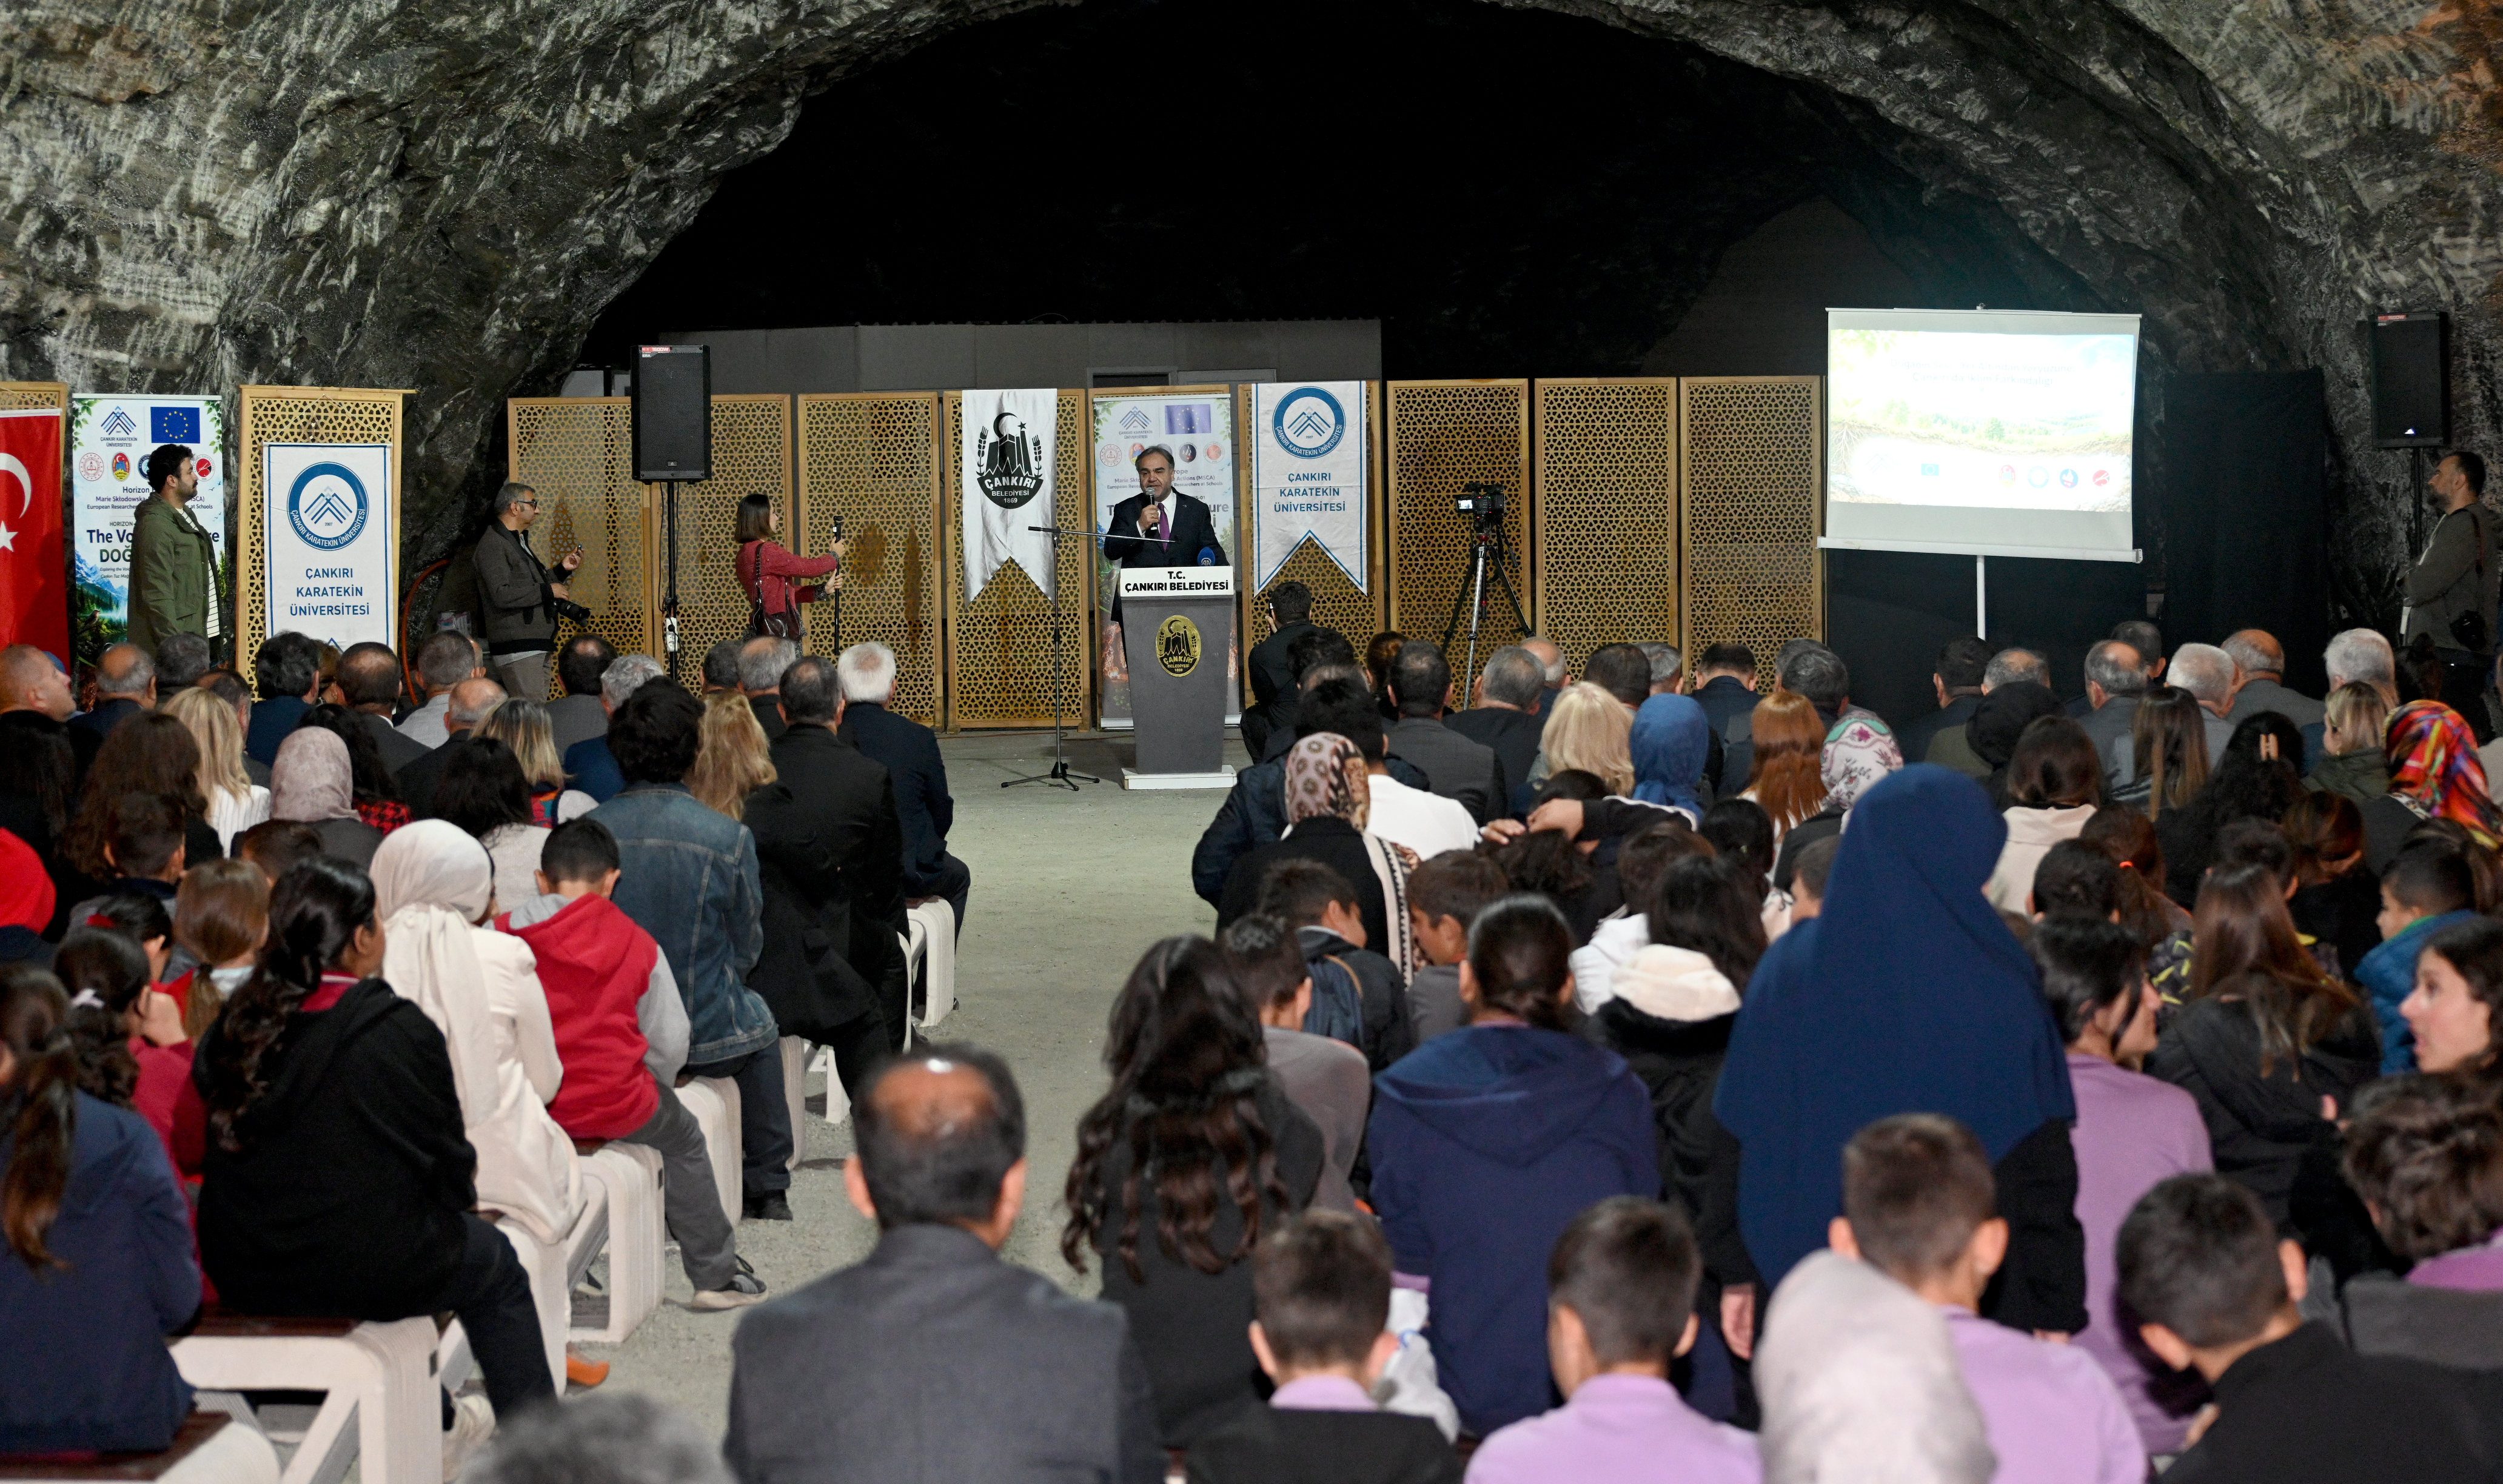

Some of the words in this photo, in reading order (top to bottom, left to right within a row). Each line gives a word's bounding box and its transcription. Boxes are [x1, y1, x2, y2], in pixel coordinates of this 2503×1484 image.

[1275, 426, 1290, 447] ÇANKIRI
[1288, 444, 1318, 456] KARATEKİN
[1318, 424, 1342, 453] ÜNİVERSİTESİ
[984, 476, 1036, 490] ÇANKIRI
[1288, 473, 1331, 483] ÇANKIRI
[1279, 486, 1339, 496] KARATEKİN
[1208, 504, 1229, 513] ure
[1274, 501, 1345, 512] ÜNİVERSİTESİ
[290, 510, 307, 535] ÇANKIRI
[305, 532, 338, 547] KARATEKİN
[338, 509, 366, 544] ÜNİVERSİTESİ
[86, 529, 113, 543] The
[306, 568, 353, 580] ÇANKIRI
[297, 584, 363, 597] KARATEKİN
[1125, 583, 1167, 593] ÇANKIRI
[1170, 580, 1228, 591] BELEDİYESİ
[290, 602, 369, 616] ÜNİVERSİTESİ
[1163, 656, 1193, 664] ÇANKIRI
